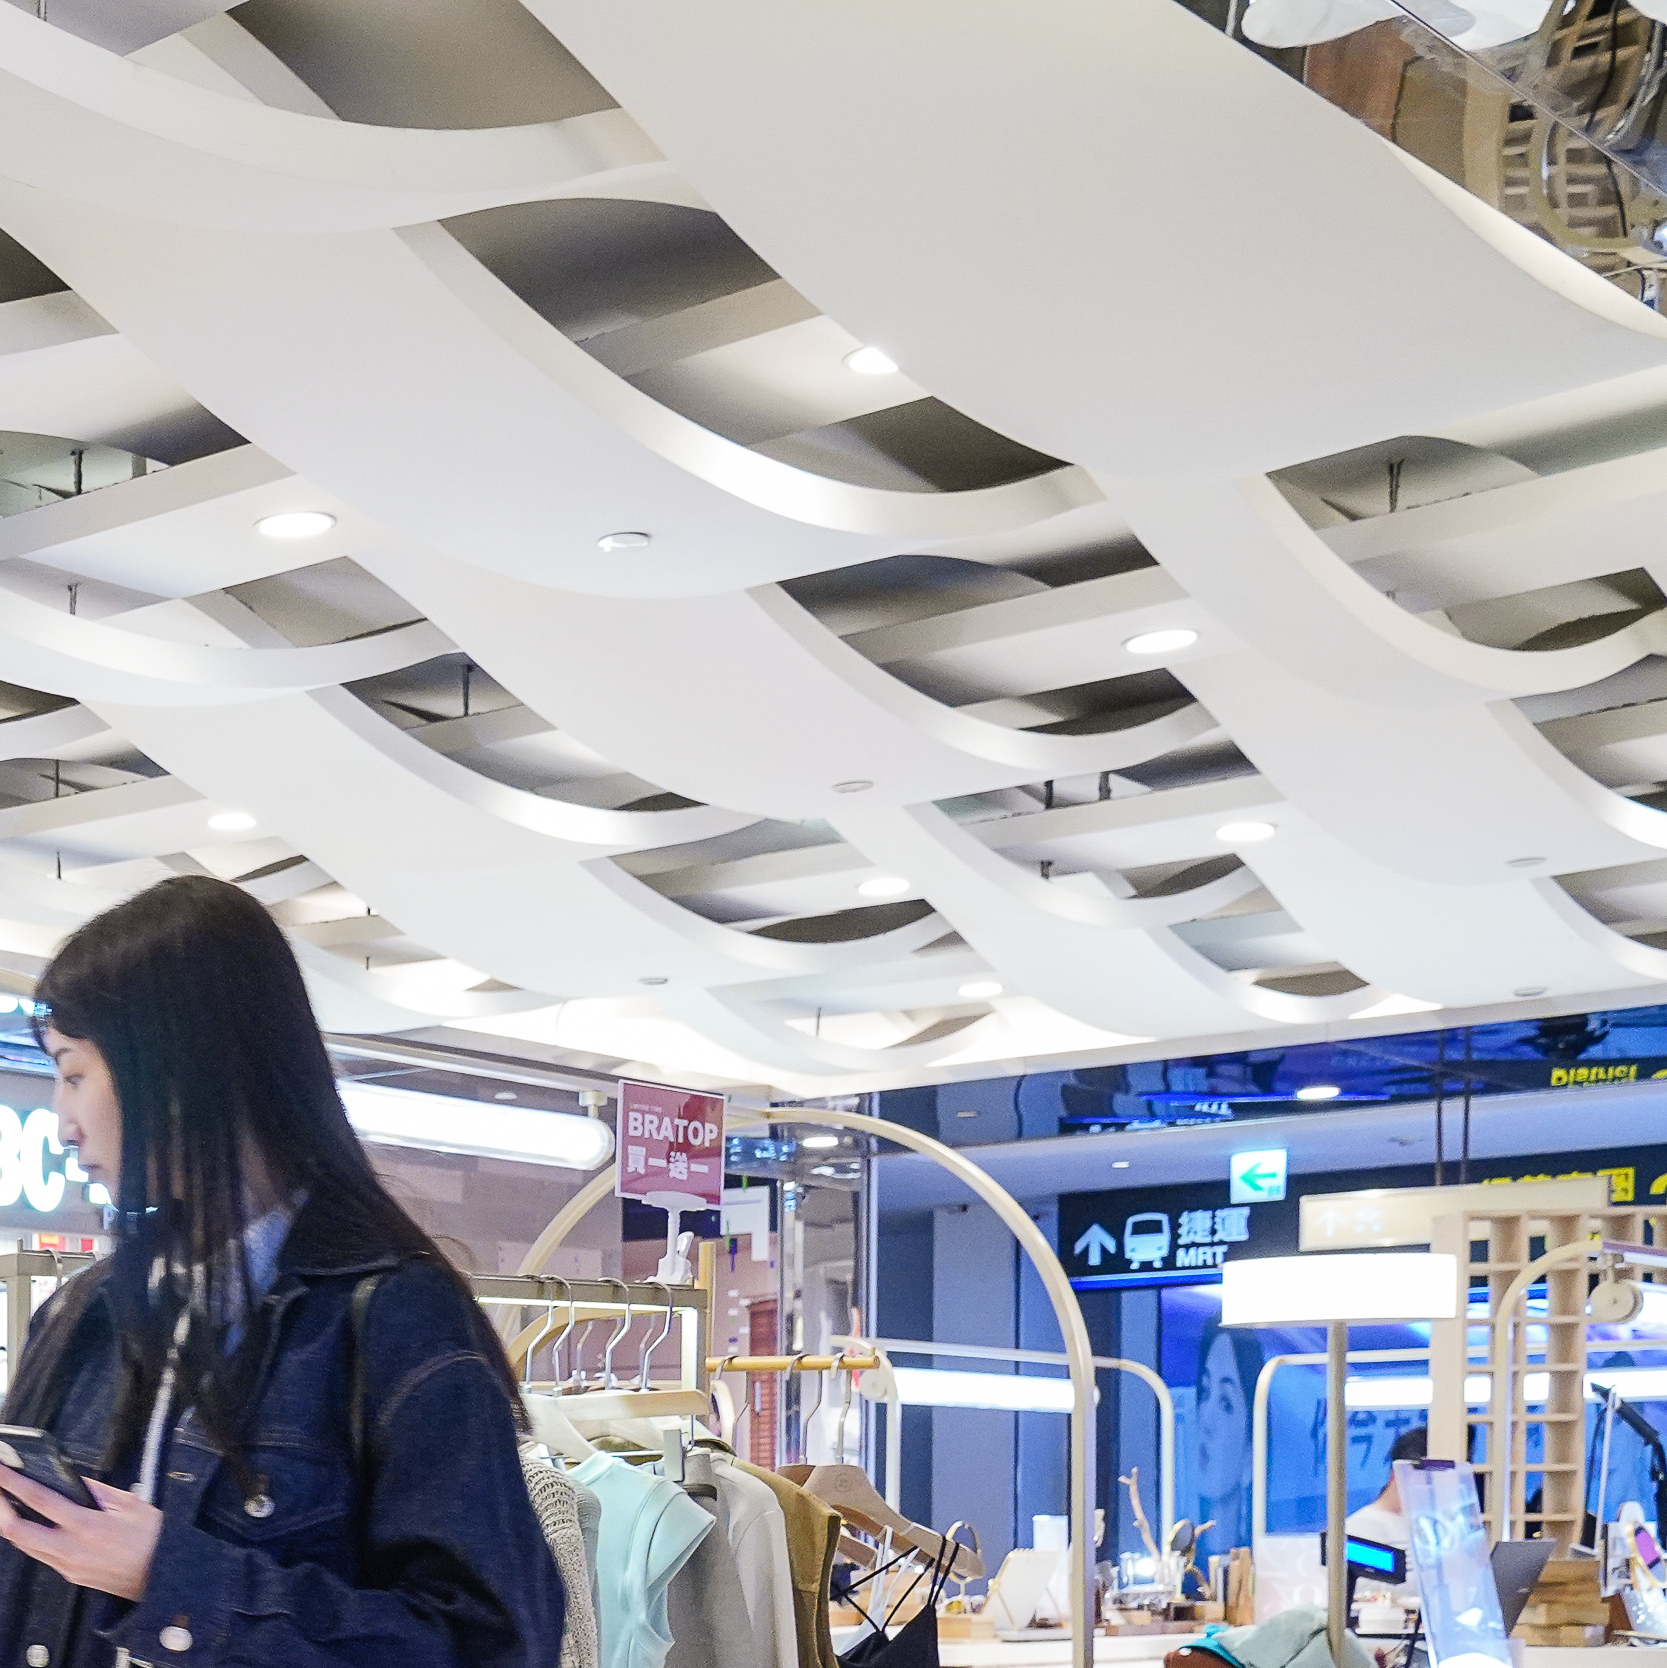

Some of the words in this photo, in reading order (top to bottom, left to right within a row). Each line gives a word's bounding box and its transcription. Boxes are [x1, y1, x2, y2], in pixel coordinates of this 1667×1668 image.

[628, 1111, 719, 1147] BRATOP
[627, 1144, 709, 1181] 買一送一
[1177, 1206, 1251, 1246] 捷運
[1176, 1244, 1229, 1268] MRT
